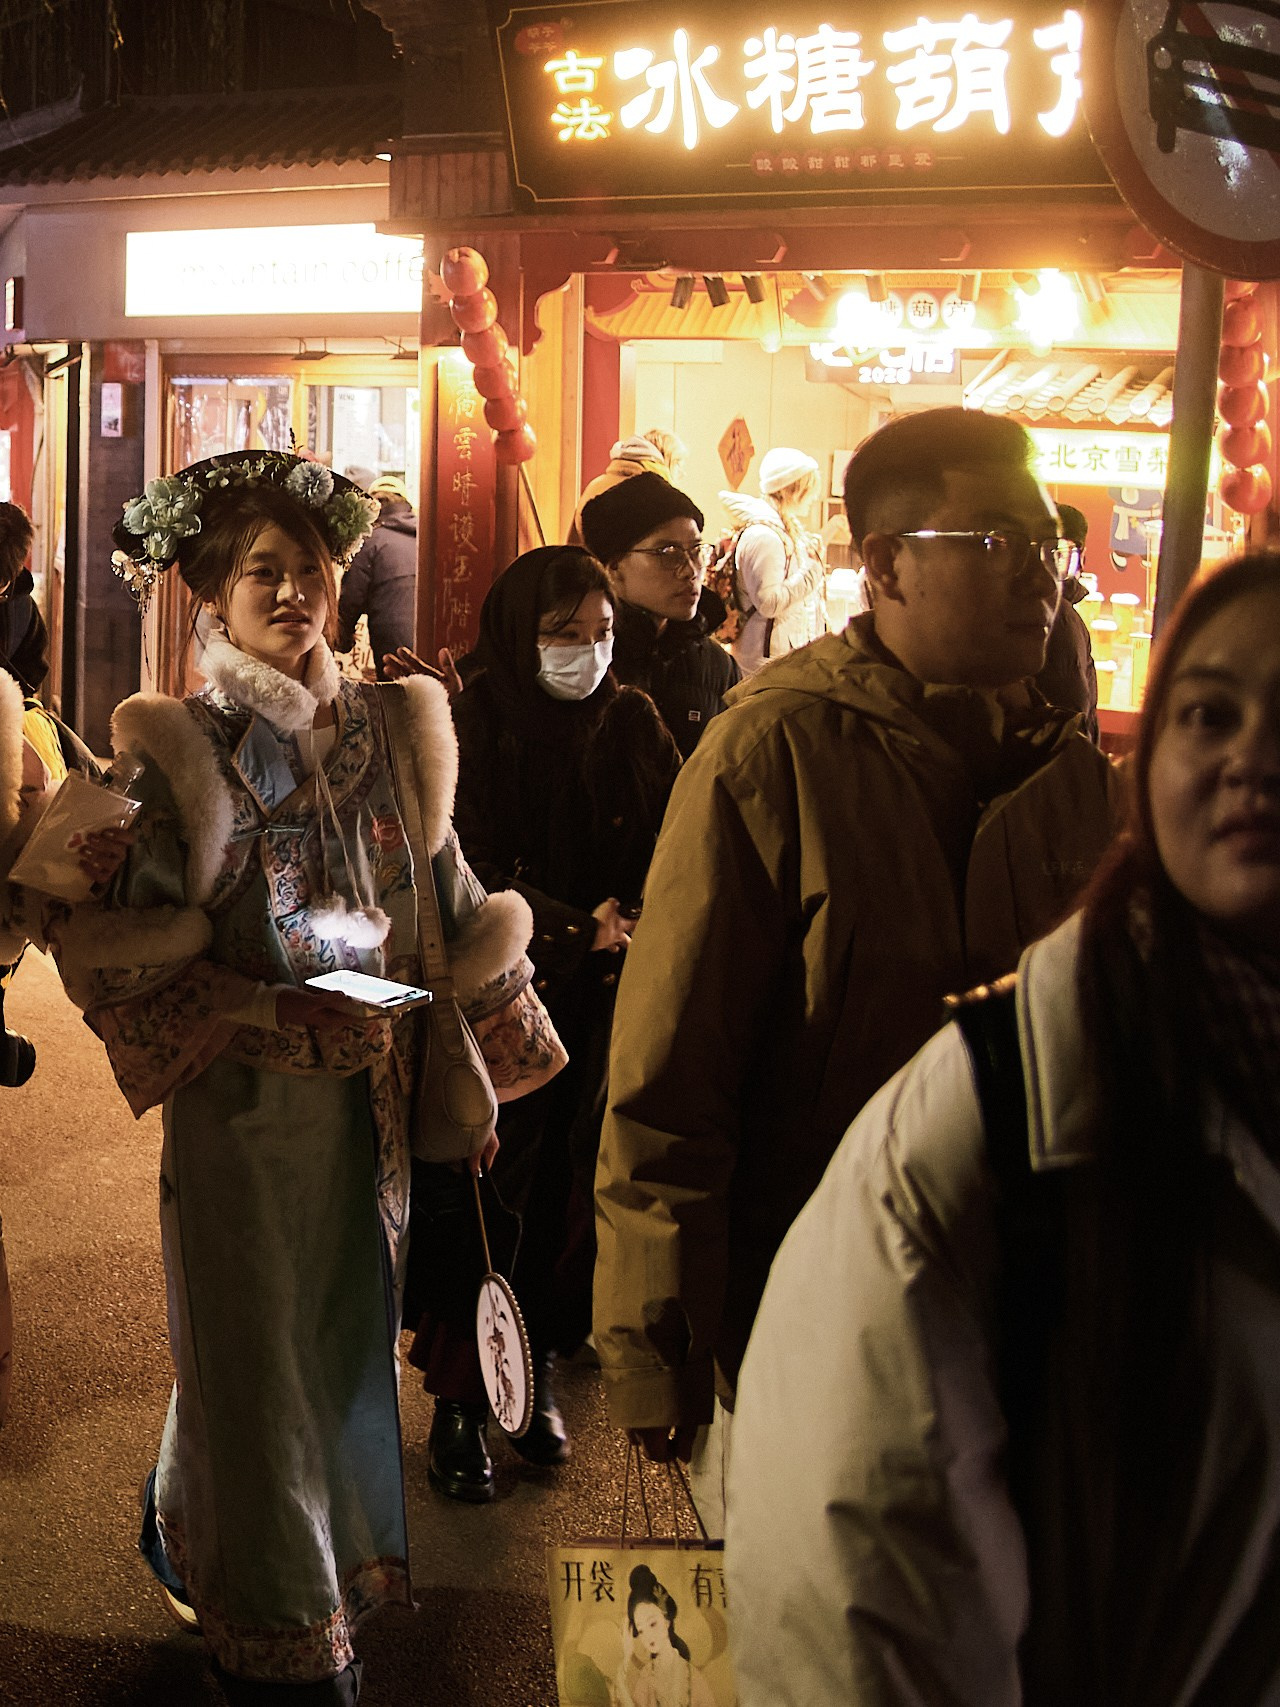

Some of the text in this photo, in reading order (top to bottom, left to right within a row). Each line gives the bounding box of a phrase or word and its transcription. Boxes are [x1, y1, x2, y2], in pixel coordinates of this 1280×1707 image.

[544, 50, 611, 142] 古法
[1035, 443, 1168, 474] 北京雪梨
[560, 1560, 615, 1602] 开袋
